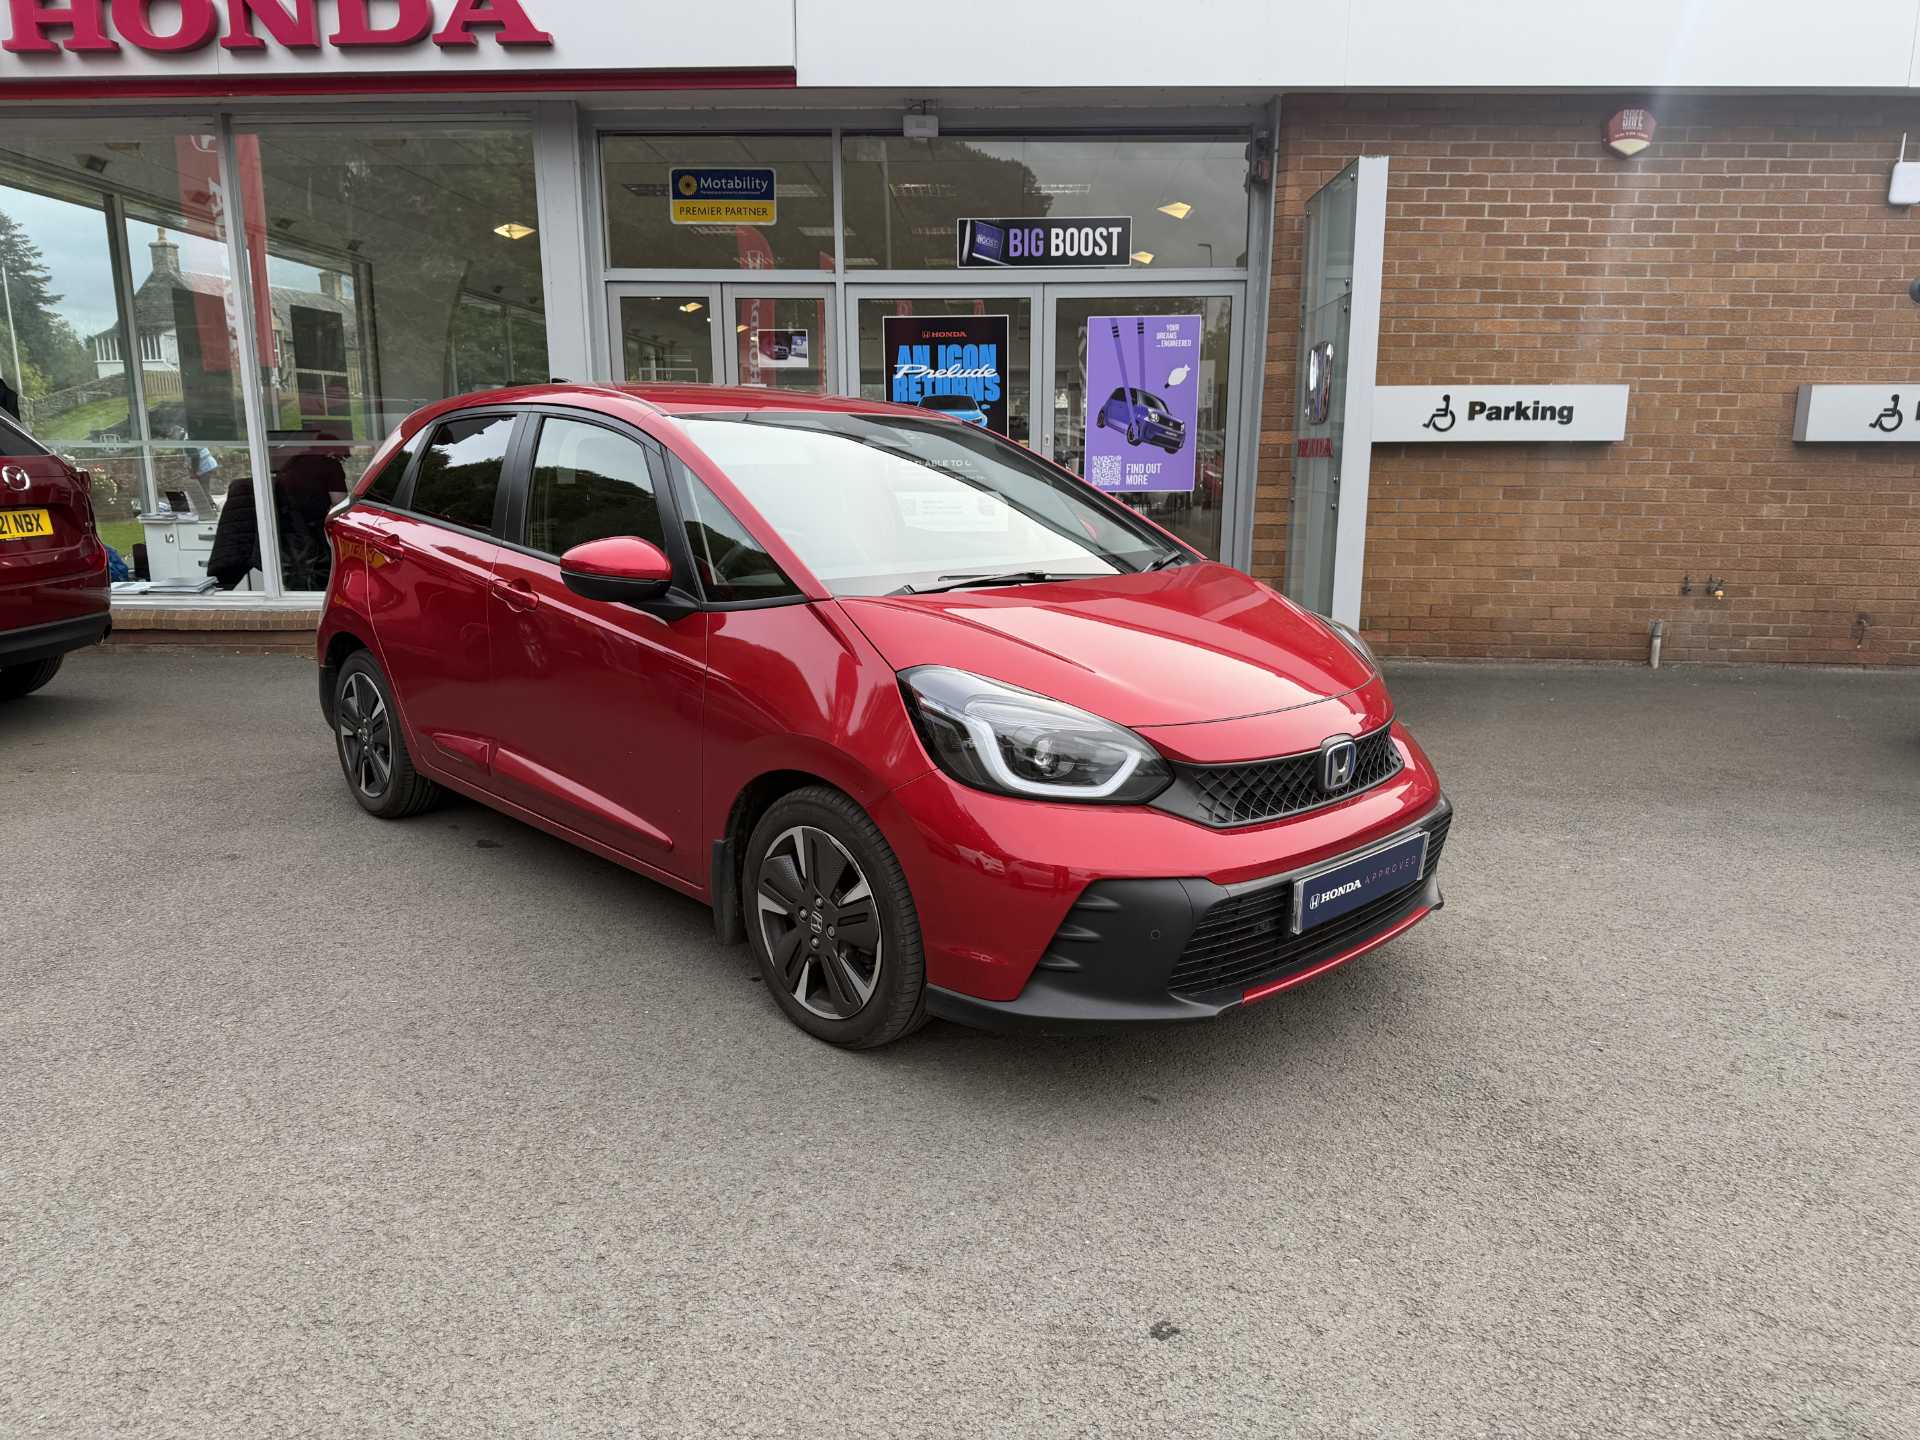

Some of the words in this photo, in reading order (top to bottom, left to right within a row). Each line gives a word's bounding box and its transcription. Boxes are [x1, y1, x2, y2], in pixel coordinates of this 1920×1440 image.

[2, 0, 554, 54] HONDA
[700, 176, 769, 192] Motability
[679, 206, 722, 216] PREMIER
[725, 206, 768, 216] PARTNER
[1008, 228, 1045, 257] BIG
[1050, 227, 1122, 256] BOOST
[896, 344, 930, 374] AN
[937, 343, 997, 372] ICON
[894, 363, 998, 379] Prelude
[892, 374, 1001, 402] RETURNS
[1467, 400, 1574, 425] Parking
[1126, 463, 1144, 474] FIND
[1146, 463, 1162, 474] OUT
[1126, 475, 1148, 485] MORE
[13, 513, 44, 533] NBX
[1320, 879, 1362, 904] HONDA
[1364, 856, 1416, 885] APPROVED
